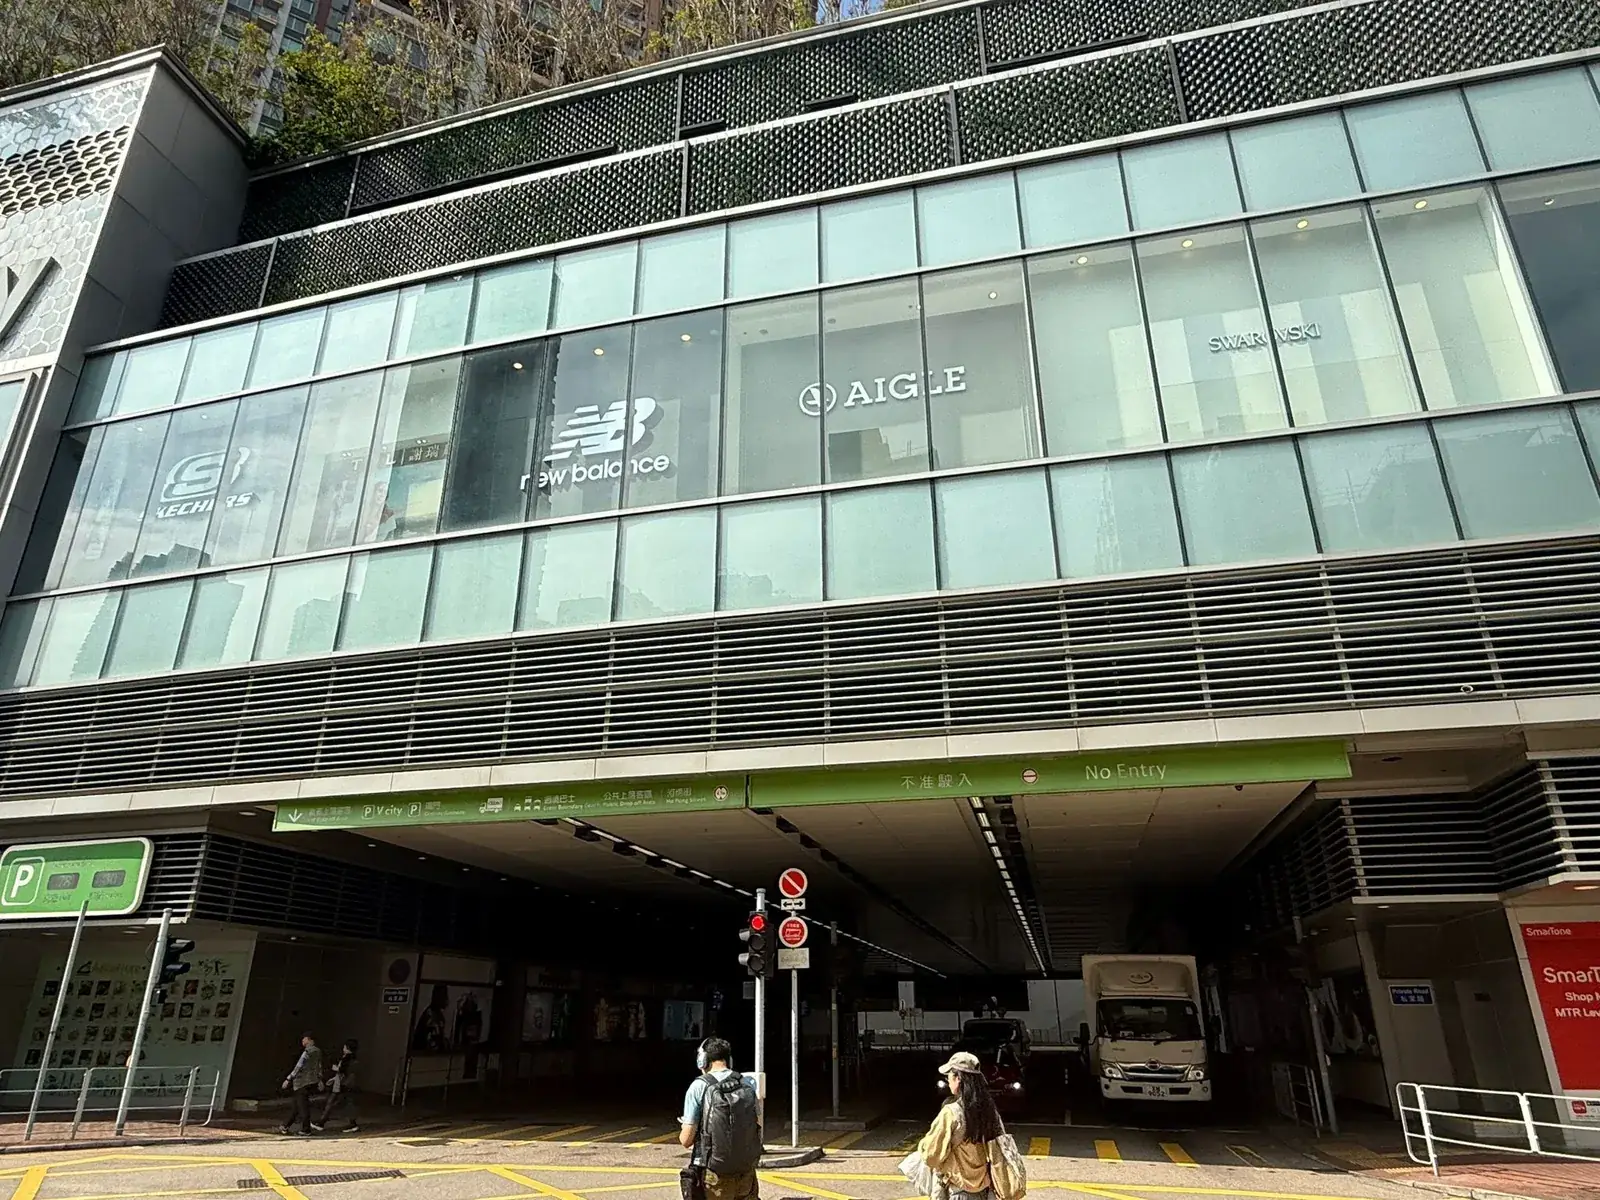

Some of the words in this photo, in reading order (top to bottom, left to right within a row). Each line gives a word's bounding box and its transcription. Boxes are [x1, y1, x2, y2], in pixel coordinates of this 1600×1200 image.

[1208, 323, 1321, 352] SWARVSKI
[843, 365, 967, 408] AIGLE
[352, 453, 397, 471] TL
[138, 492, 253, 521] KECHRS
[1085, 764, 1111, 781] No
[1116, 762, 1167, 781] Entry
[900, 773, 973, 790] 不准駛入
[376, 806, 384, 816] V
[384, 804, 403, 817] city
[10, 864, 35, 899] P
[1525, 926, 1572, 936] SmarTone
[1564, 991, 1594, 1003] Shop
[1554, 1007, 1582, 1017] MTR
